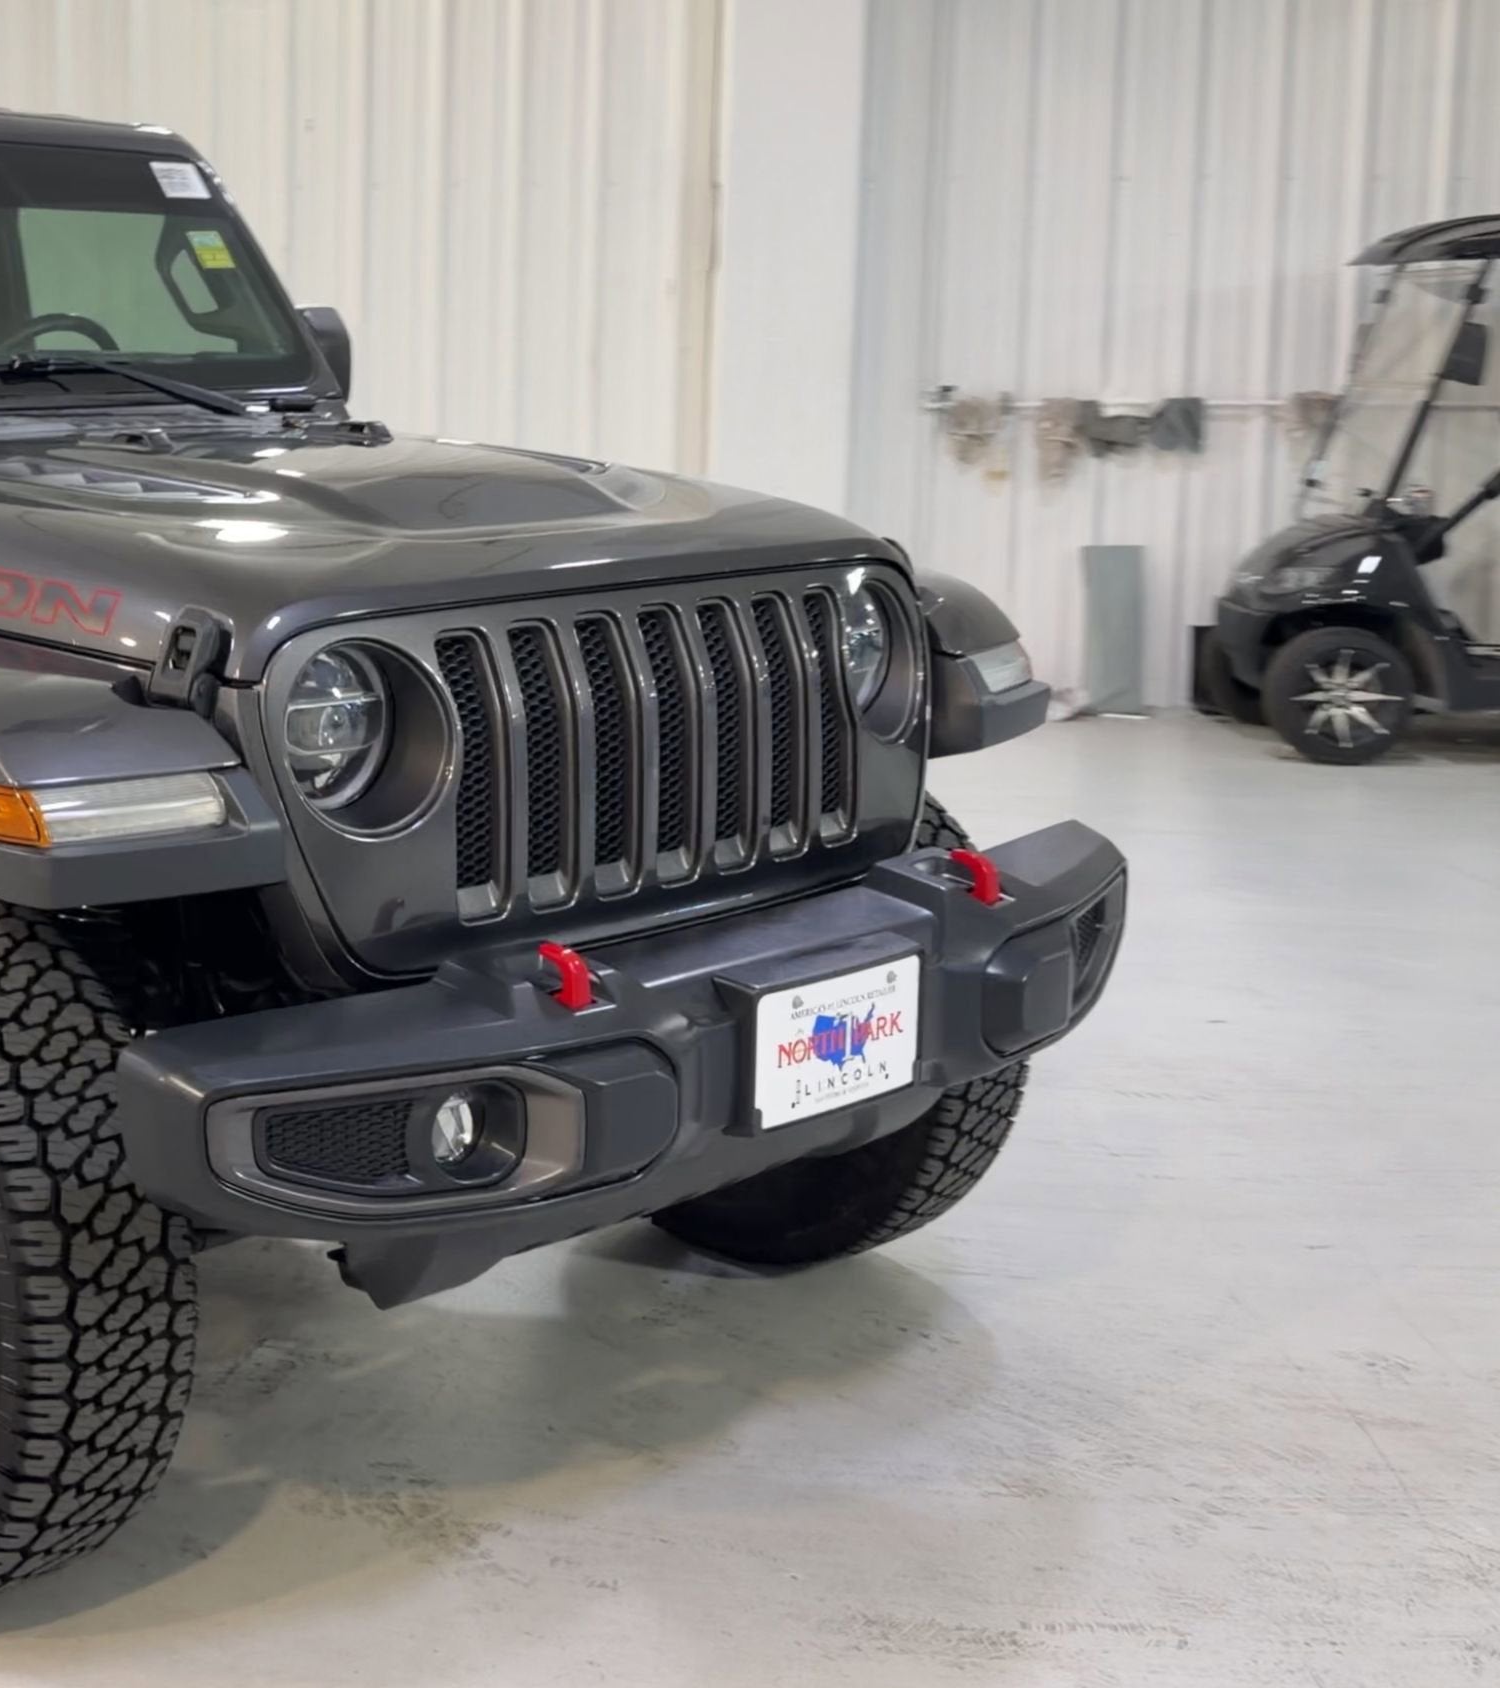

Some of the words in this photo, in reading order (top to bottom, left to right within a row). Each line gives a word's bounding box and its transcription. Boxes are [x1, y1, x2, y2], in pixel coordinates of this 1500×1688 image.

[777, 1026, 847, 1069] NORTH
[852, 1011, 904, 1047] PARK
[804, 1061, 887, 1096] LINCOLN
